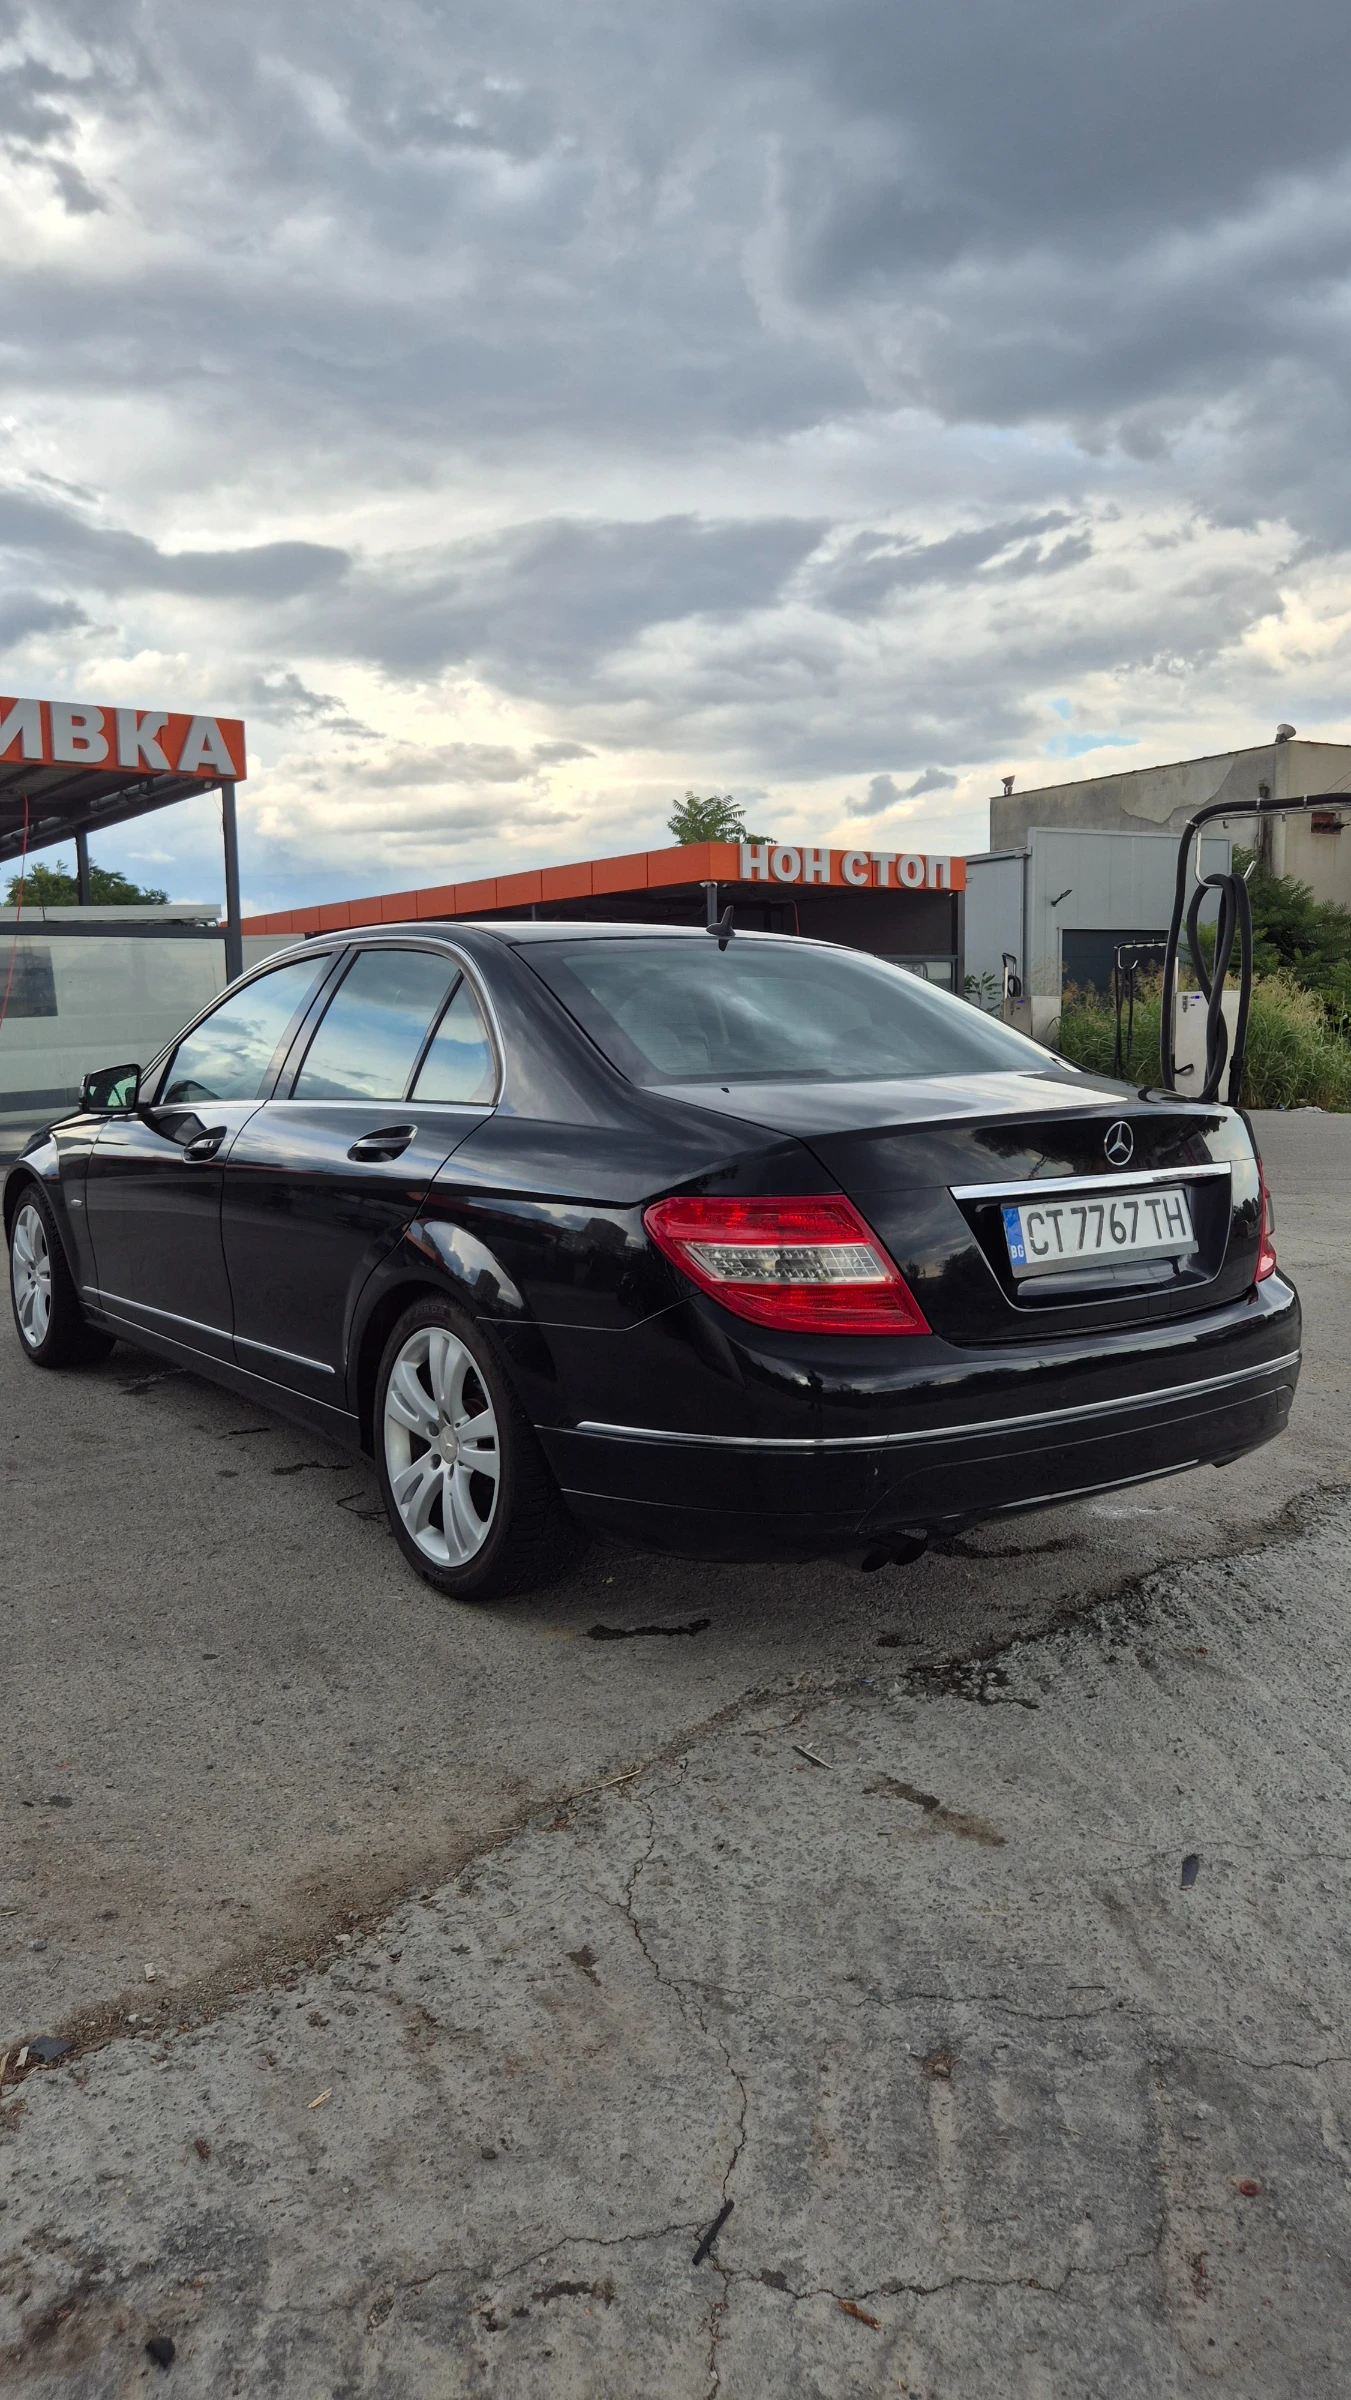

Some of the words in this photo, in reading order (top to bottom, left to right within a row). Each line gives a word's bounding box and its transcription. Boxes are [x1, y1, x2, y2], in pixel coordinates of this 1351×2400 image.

[739, 843, 831, 884] НОН
[841, 850, 951, 889] СТОП
[1010, 1244, 1025, 1259] BG
[415, 1303, 445, 1316] FULDA
